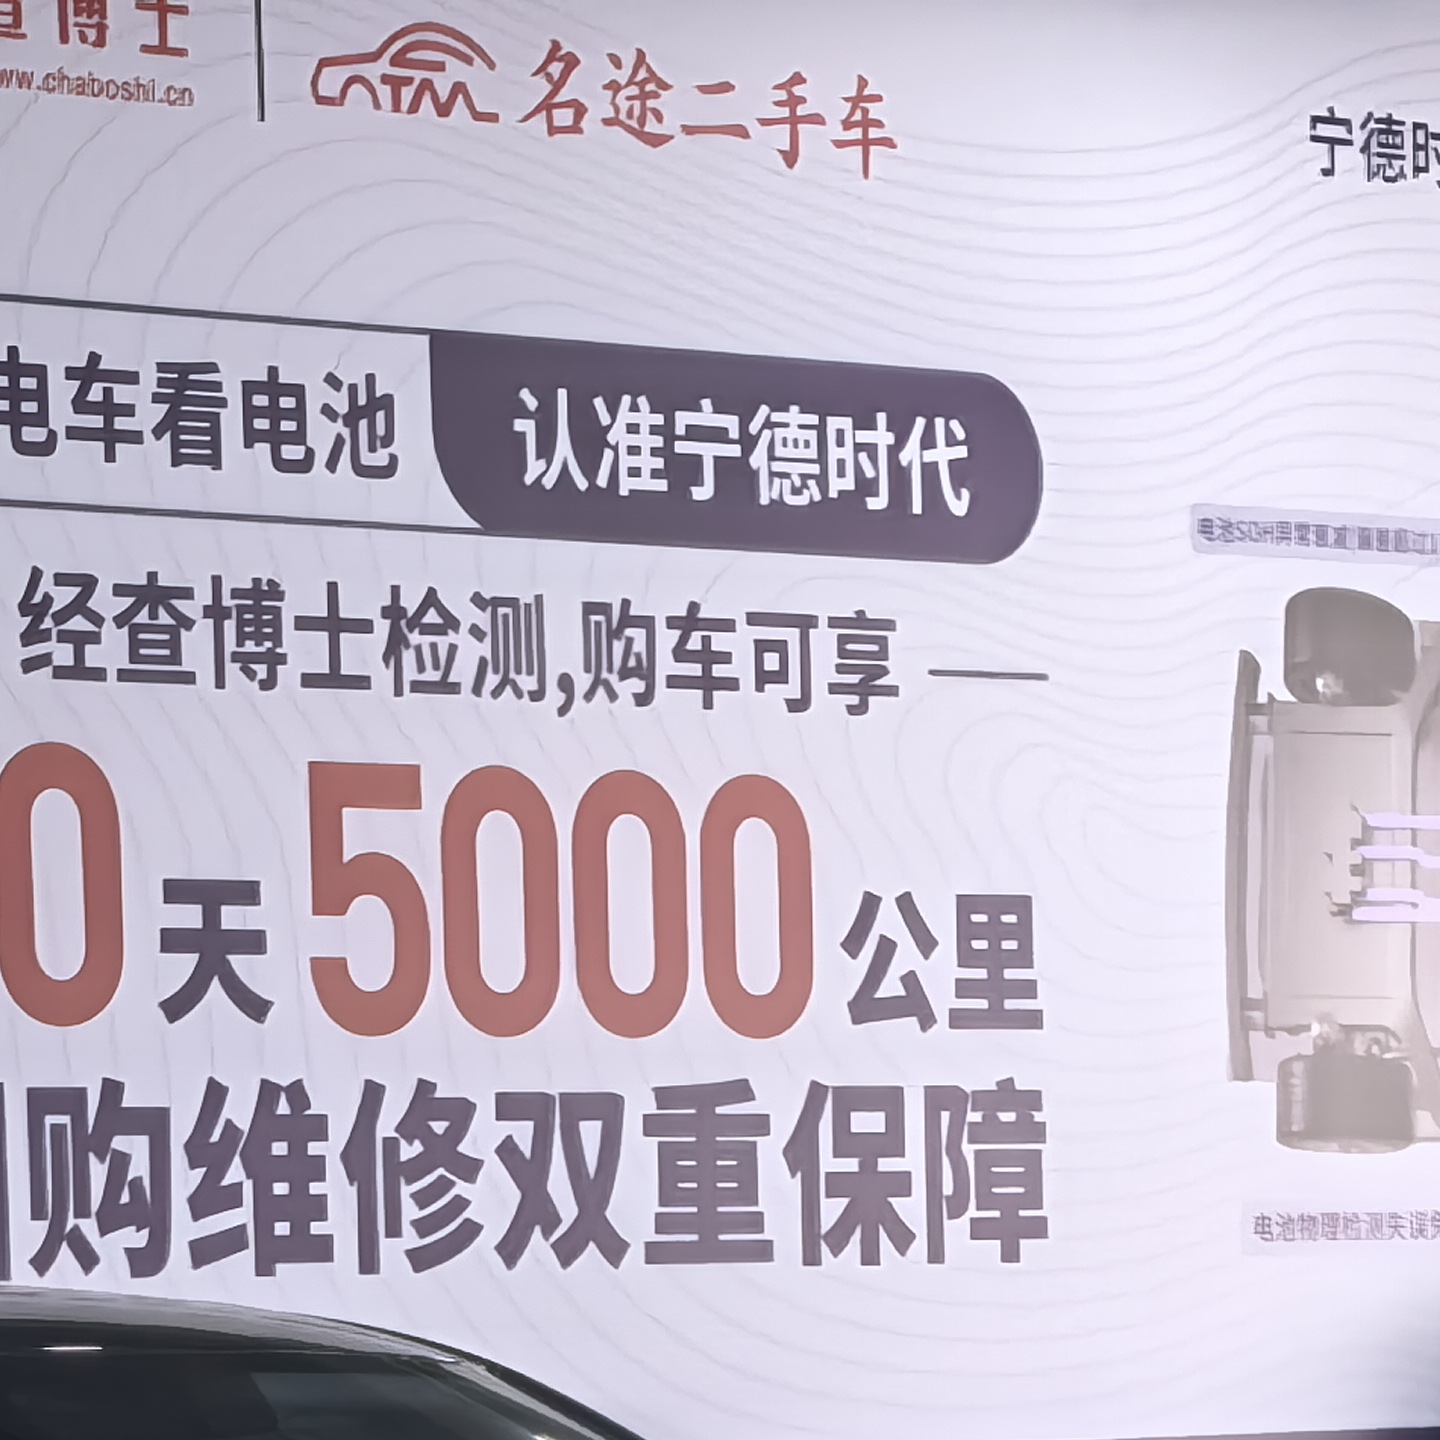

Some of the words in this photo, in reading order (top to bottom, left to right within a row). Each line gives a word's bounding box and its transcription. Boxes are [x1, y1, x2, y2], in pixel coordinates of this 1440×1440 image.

[518, 40, 898, 180] 名途二手车
[512, 386, 971, 517] 认准宁德时代
[17, 565, 900, 718] 经查博士检测,购车可享
